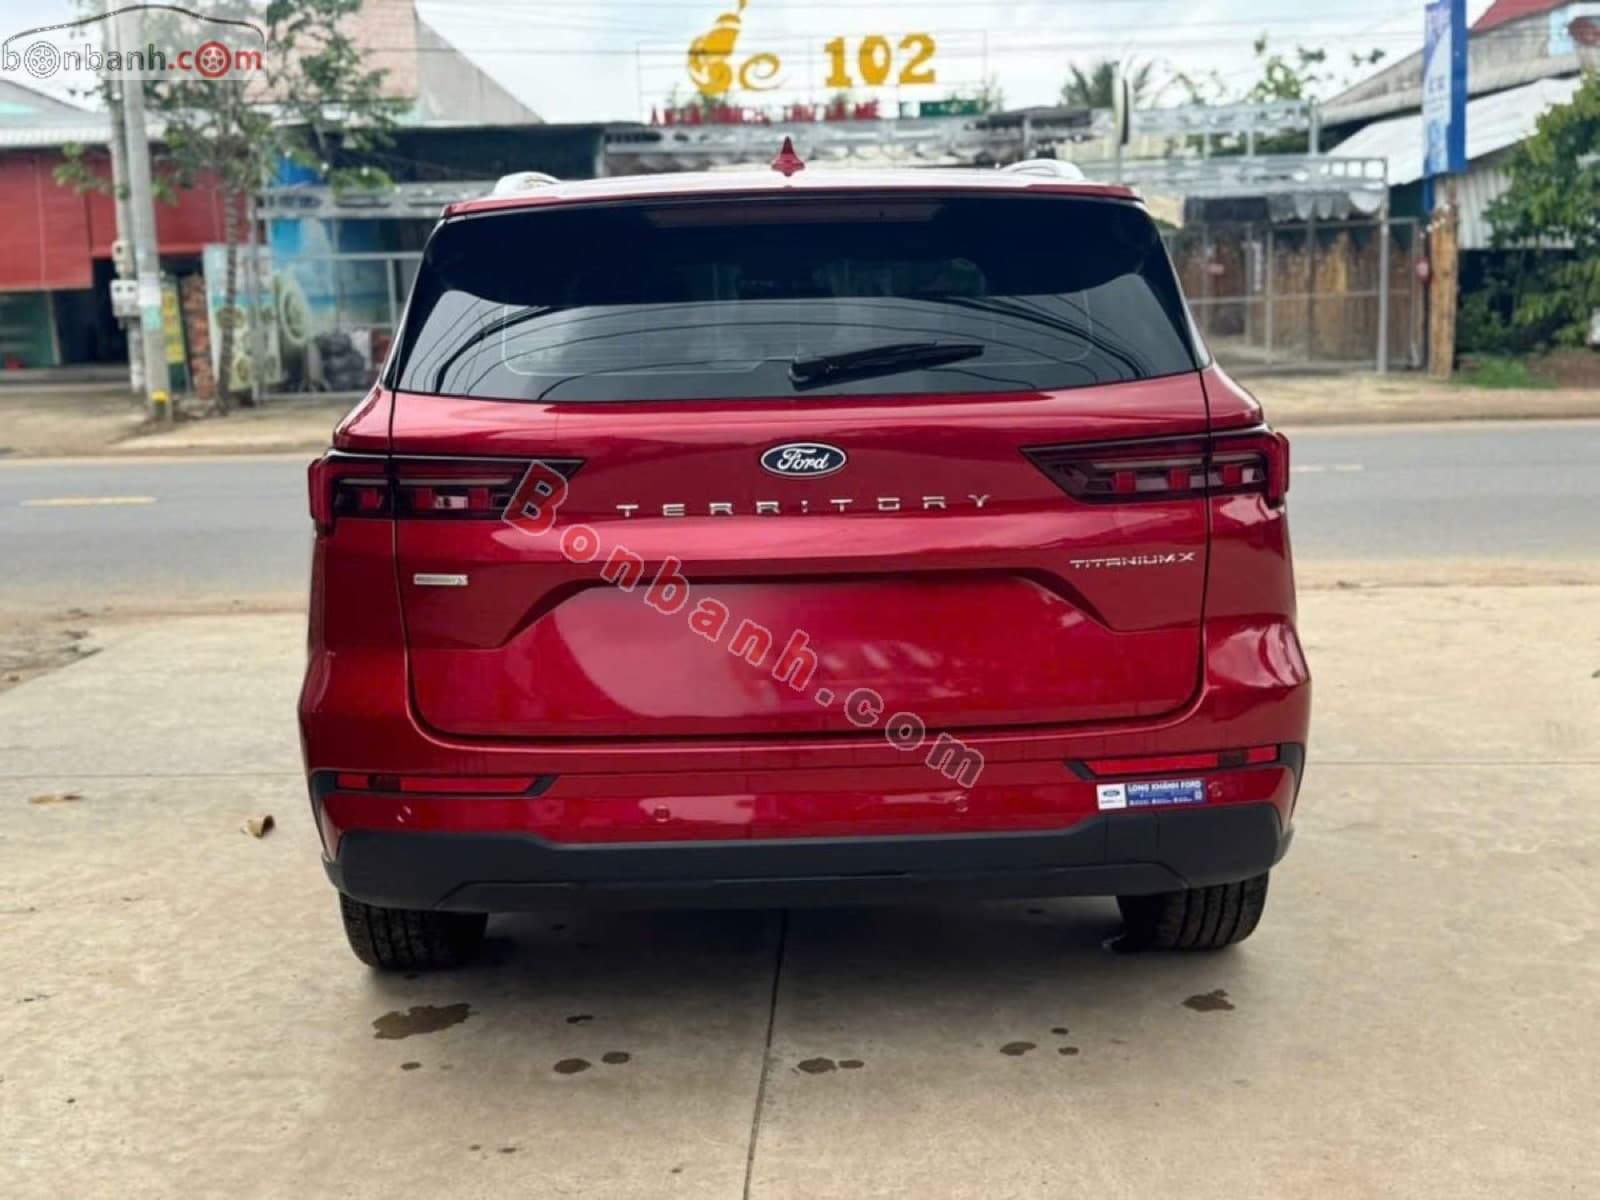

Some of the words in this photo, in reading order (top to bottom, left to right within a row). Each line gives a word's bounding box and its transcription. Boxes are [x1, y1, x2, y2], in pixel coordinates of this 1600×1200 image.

[823, 33, 937, 88] 102
[777, 447, 830, 471] Ford
[616, 494, 990, 517] TERRITORY
